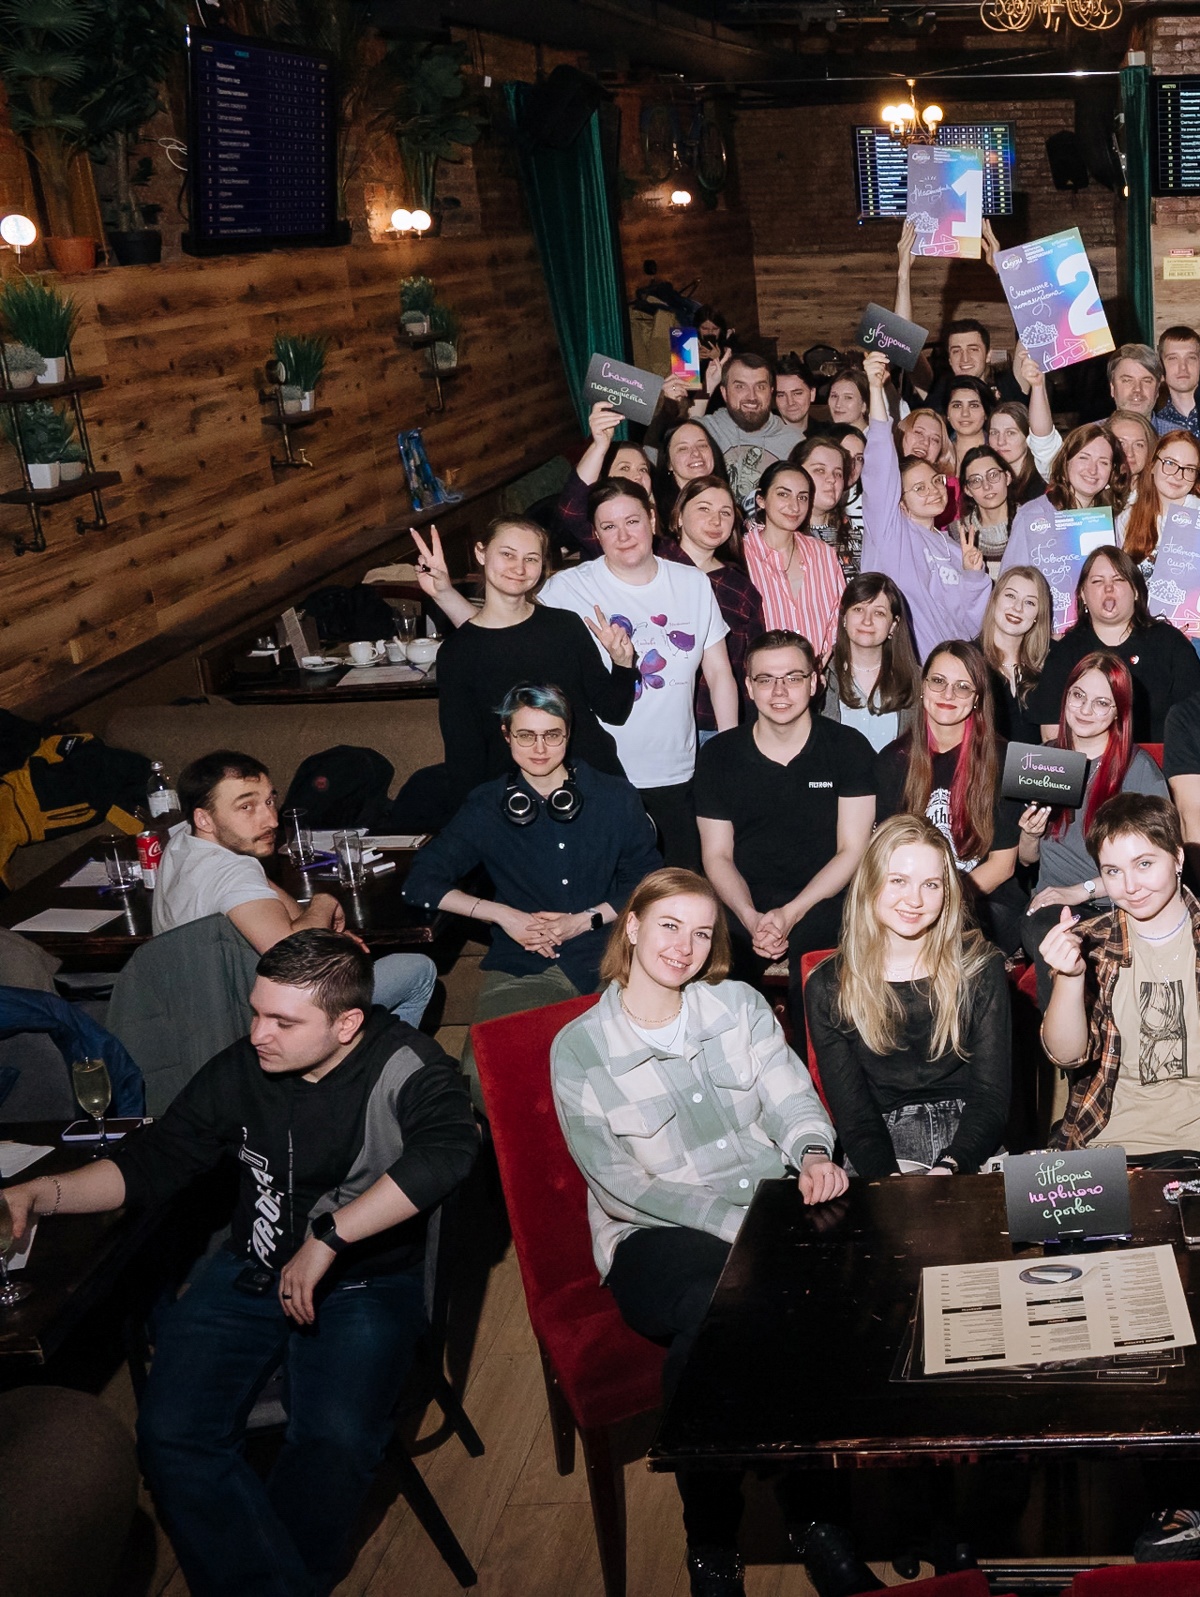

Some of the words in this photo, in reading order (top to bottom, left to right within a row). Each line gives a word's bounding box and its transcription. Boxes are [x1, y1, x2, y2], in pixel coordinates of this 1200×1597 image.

[951, 169, 983, 237] 1
[1056, 252, 1108, 336] 2
[682, 337, 700, 371] 1
[1035, 1159, 1092, 1190] Теория
[1028, 1184, 1103, 1207] нервного
[1043, 1197, 1095, 1224] срыва
